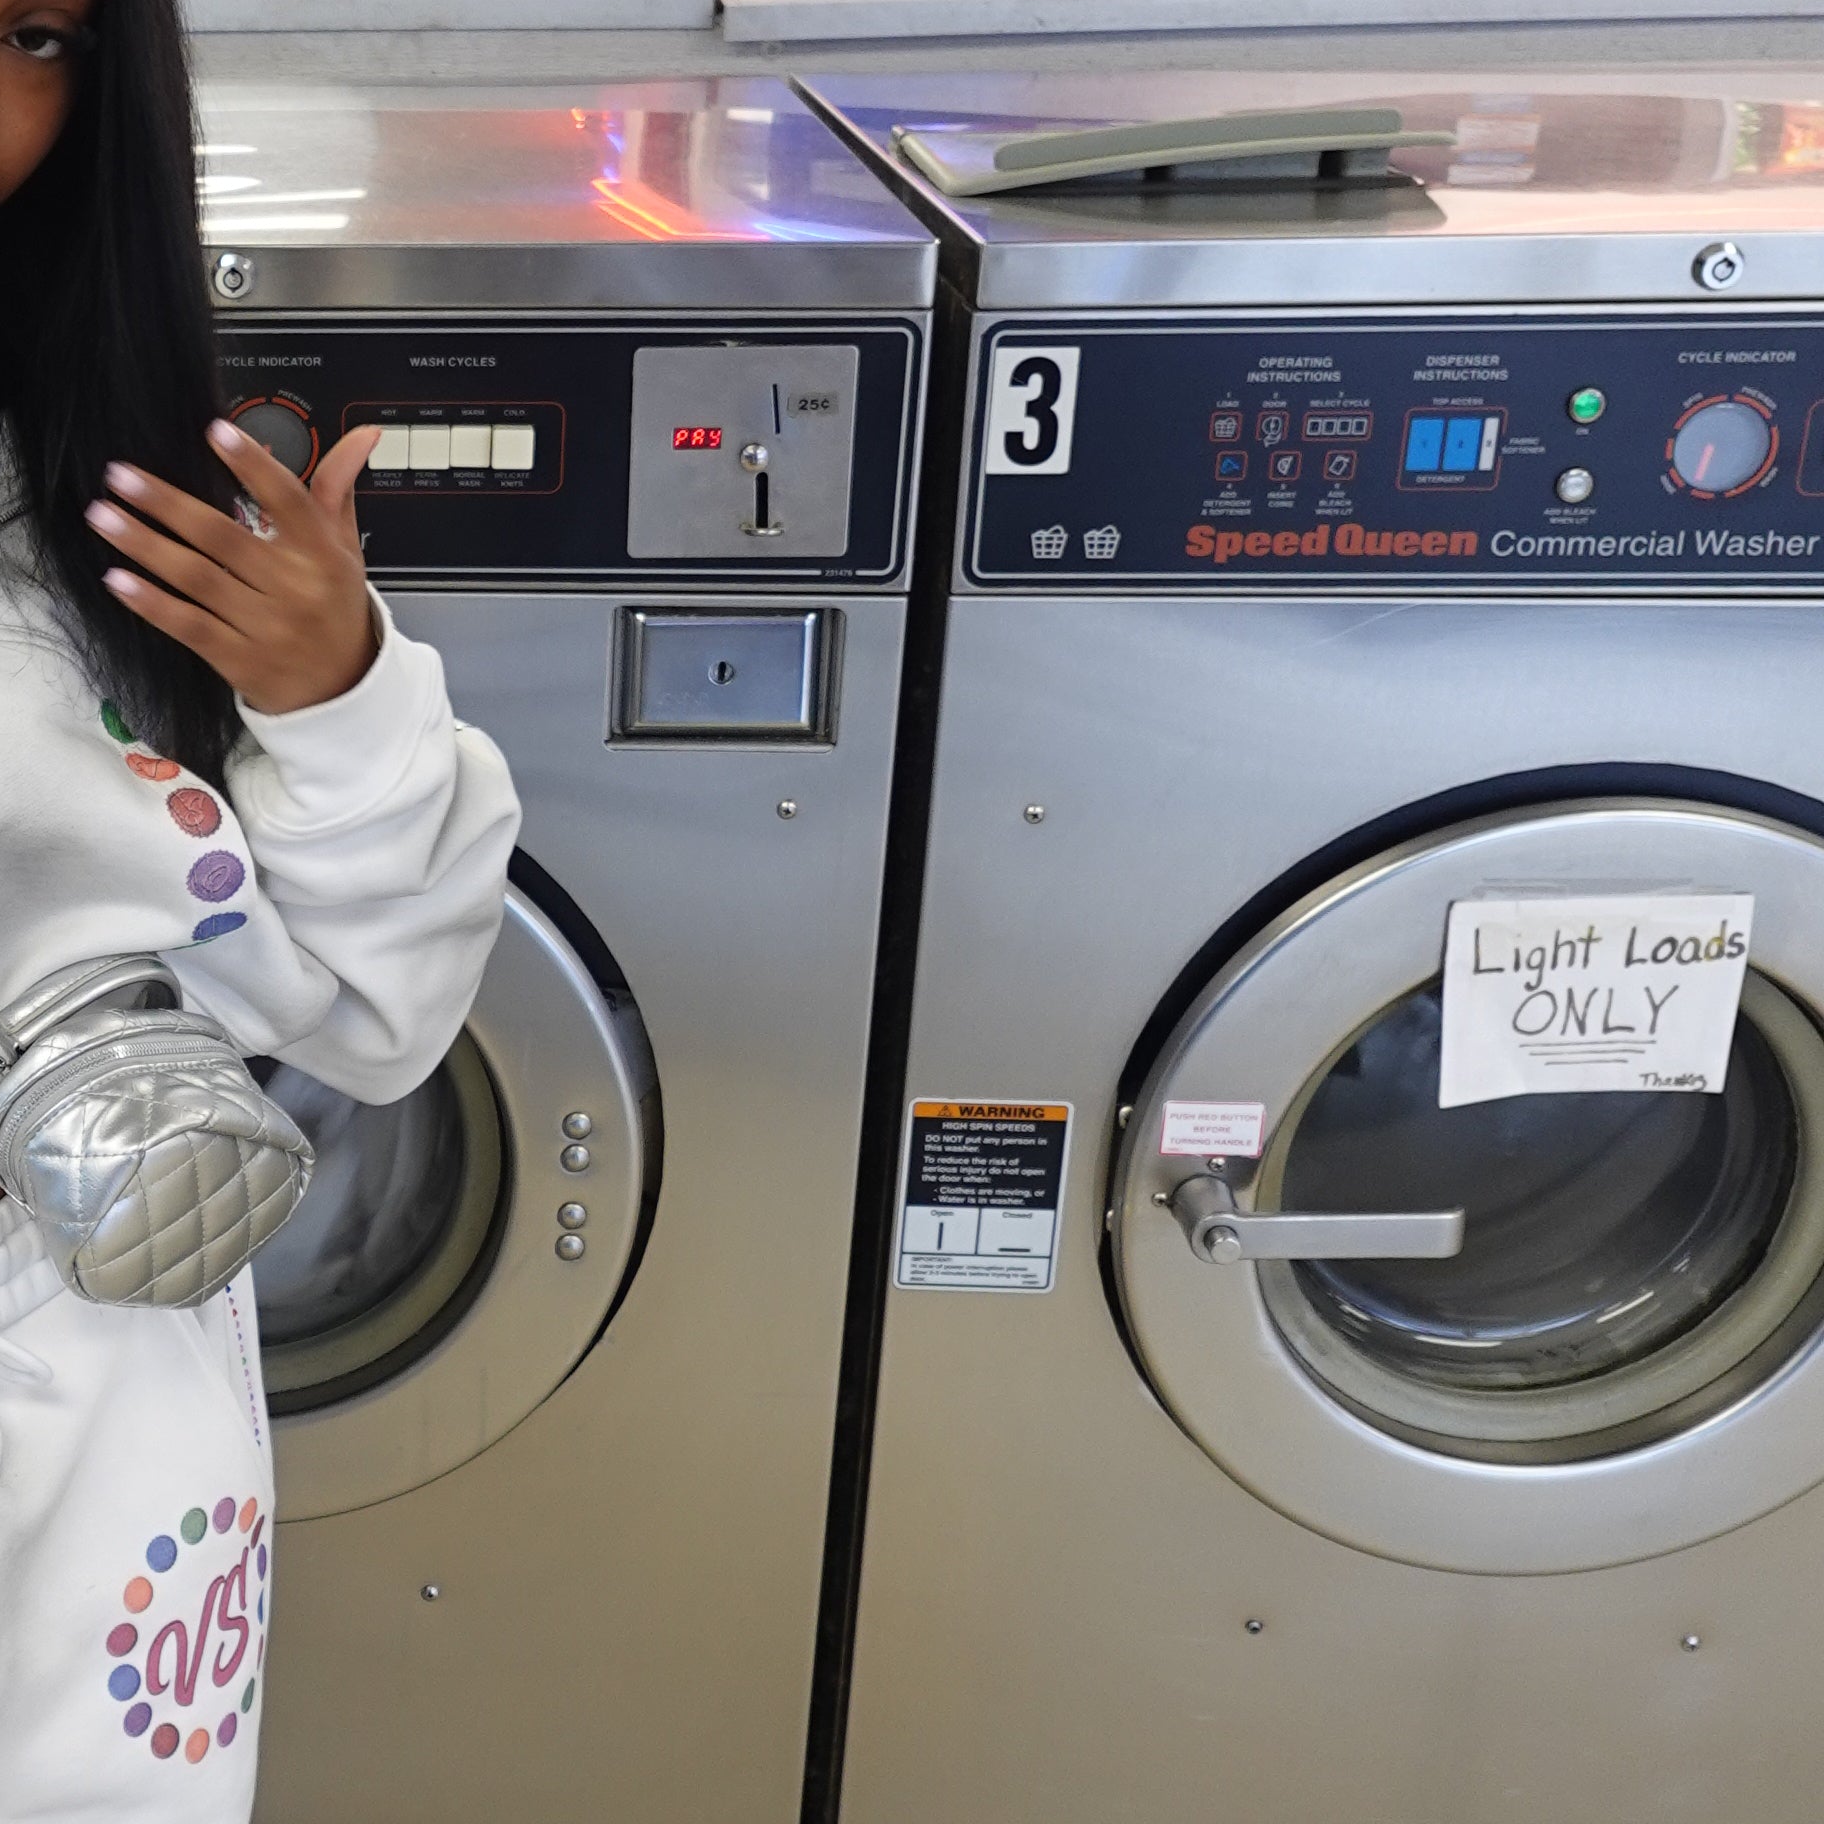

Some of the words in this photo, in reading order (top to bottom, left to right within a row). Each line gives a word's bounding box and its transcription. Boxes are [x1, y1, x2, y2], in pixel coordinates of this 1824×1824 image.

[216, 357, 255, 367] CYCLE
[258, 356, 322, 367] INDICATOR
[409, 357, 445, 367] WASH
[448, 357, 497, 367] CYCLES
[1258, 356, 1334, 369] OPERATING
[1426, 354, 1501, 367] DISPENSER
[1677, 351, 1723, 364] CYCLE
[1725, 350, 1797, 363] INDICATOR
[1247, 370, 1342, 383] INSTRUCTIONS
[1413, 368, 1509, 381] INSTRUCTIONS
[1003, 356, 1062, 466] 3
[1185, 524, 1330, 564] Speed
[1334, 525, 1478, 556] Queen
[1489, 528, 1682, 558] Commercial
[1694, 528, 1820, 556] Washer
[1472, 925, 1603, 991] Light
[1623, 918, 1746, 969] Loads
[1511, 985, 1680, 1036] ONLY
[958, 1105, 1045, 1119] WARNING
[1169, 1113, 1196, 1121] PUSH
[1197, 1113, 1218, 1121] RED
[1219, 1114, 1258, 1122] BUTTON
[942, 1122, 967, 1130] HIGH
[968, 1122, 993, 1131] SPIN
[995, 1123, 1036, 1132] SPEEDS
[925, 1135, 940, 1143] DO
[942, 1135, 963, 1144] NOT
[965, 1136, 982, 1145] put
[983, 1138, 1001, 1146] any
[1002, 1138, 1036, 1146] person
[1037, 1137, 1048, 1146] in
[924, 1156, 934, 1164] To
[937, 1156, 969, 1165] reduce
[971, 1156, 987, 1165] the
[988, 1157, 1007, 1166] risk
[1008, 1157, 1020, 1166] of
[922, 1166, 957, 1174] serious
[959, 1166, 987, 1176] injury
[988, 1167, 1001, 1175] do
[938, 1175, 962, 1183] door
[977, 1188, 993, 1196] are
[938, 1196, 966, 1204] Water
[967, 1196, 976, 1204] is
[978, 1196, 987, 1204] in
[930, 1209, 955, 1218] Open
